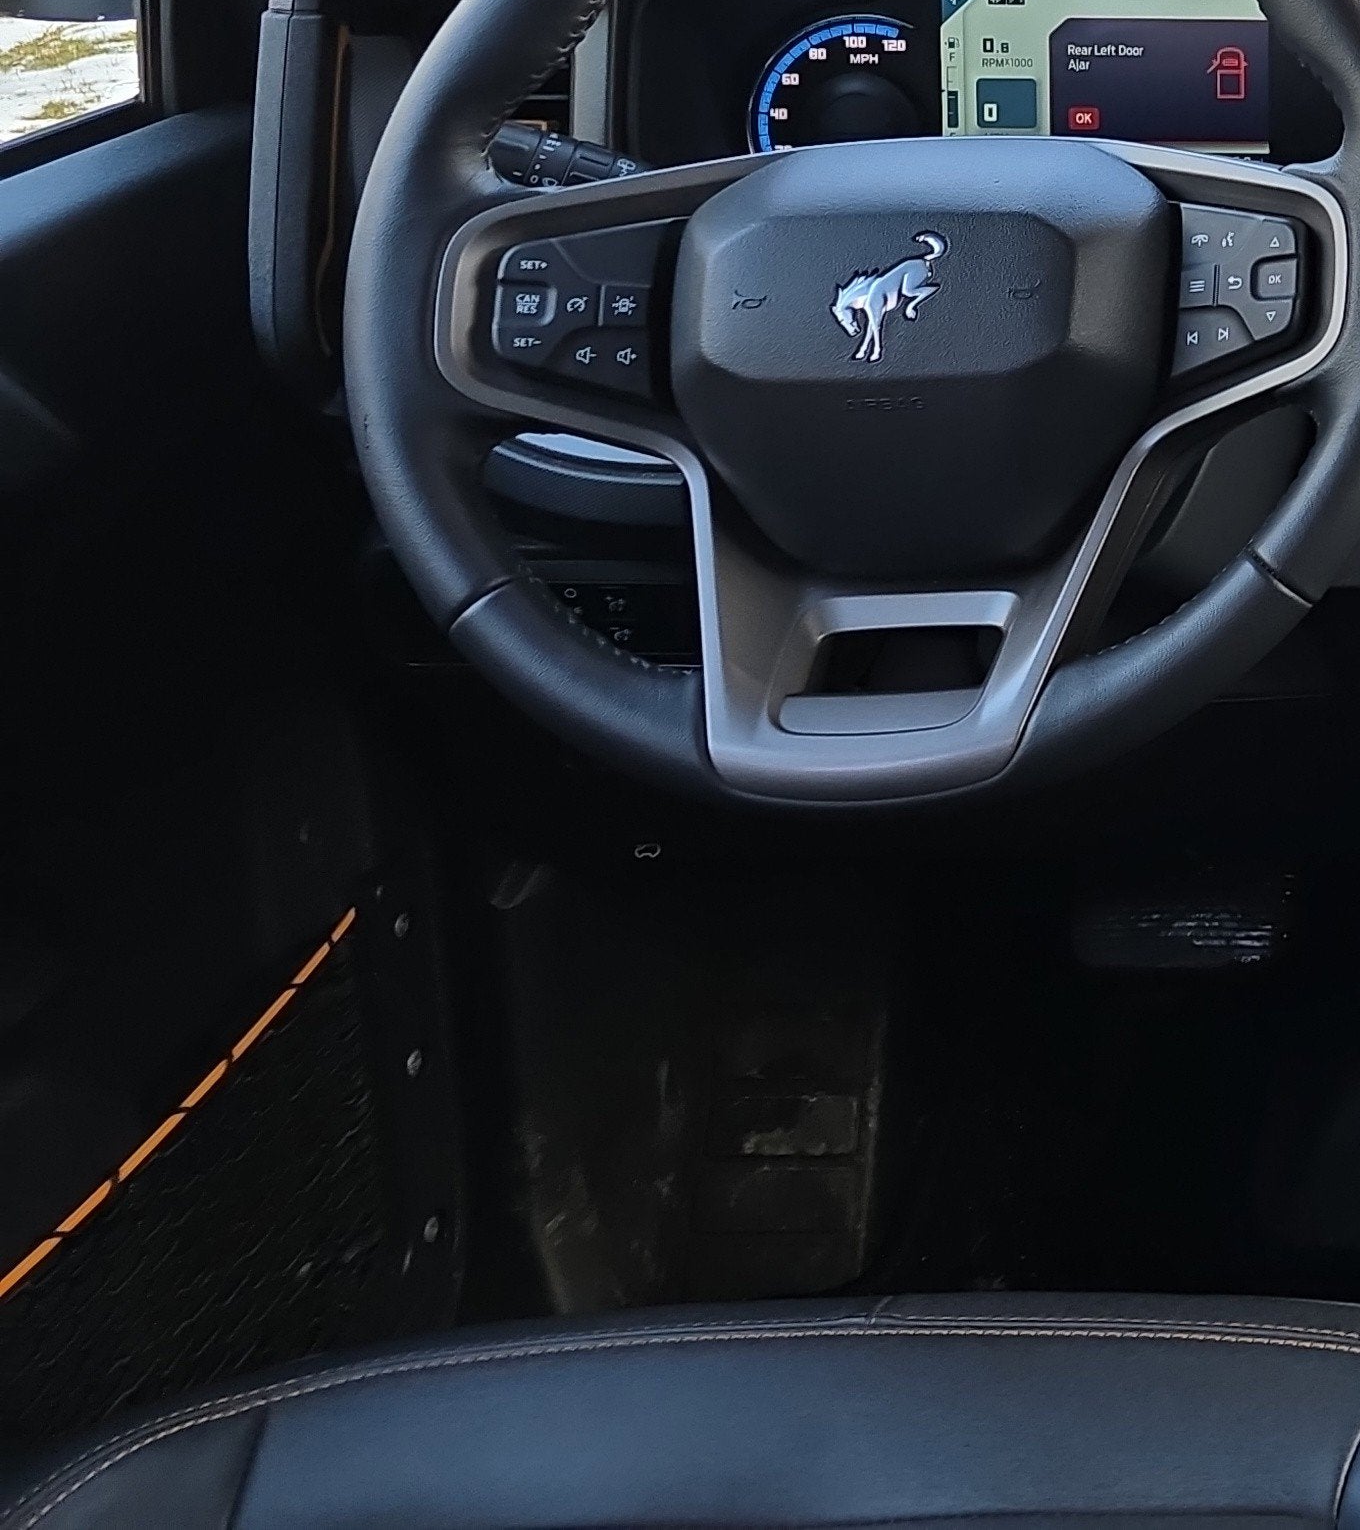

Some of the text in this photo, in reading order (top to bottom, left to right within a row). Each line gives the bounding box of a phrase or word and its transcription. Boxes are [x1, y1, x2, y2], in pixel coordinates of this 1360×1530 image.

[843, 36, 867, 48] 100
[882, 39, 907, 52] 120
[809, 48, 827, 60] 80
[1067, 45, 1144, 56] Rear Left Door
[849, 54, 879, 65] MPH
[949, 52, 955, 62] F
[1068, 59, 1090, 72] Ajar
[781, 74, 800, 85] 60
[769, 108, 788, 120] 40
[983, 103, 998, 122] 0
[1075, 113, 1093, 124] OK
[1268, 274, 1282, 284] OK
[515, 293, 540, 303] CAN
[516, 304, 538, 314] RES
